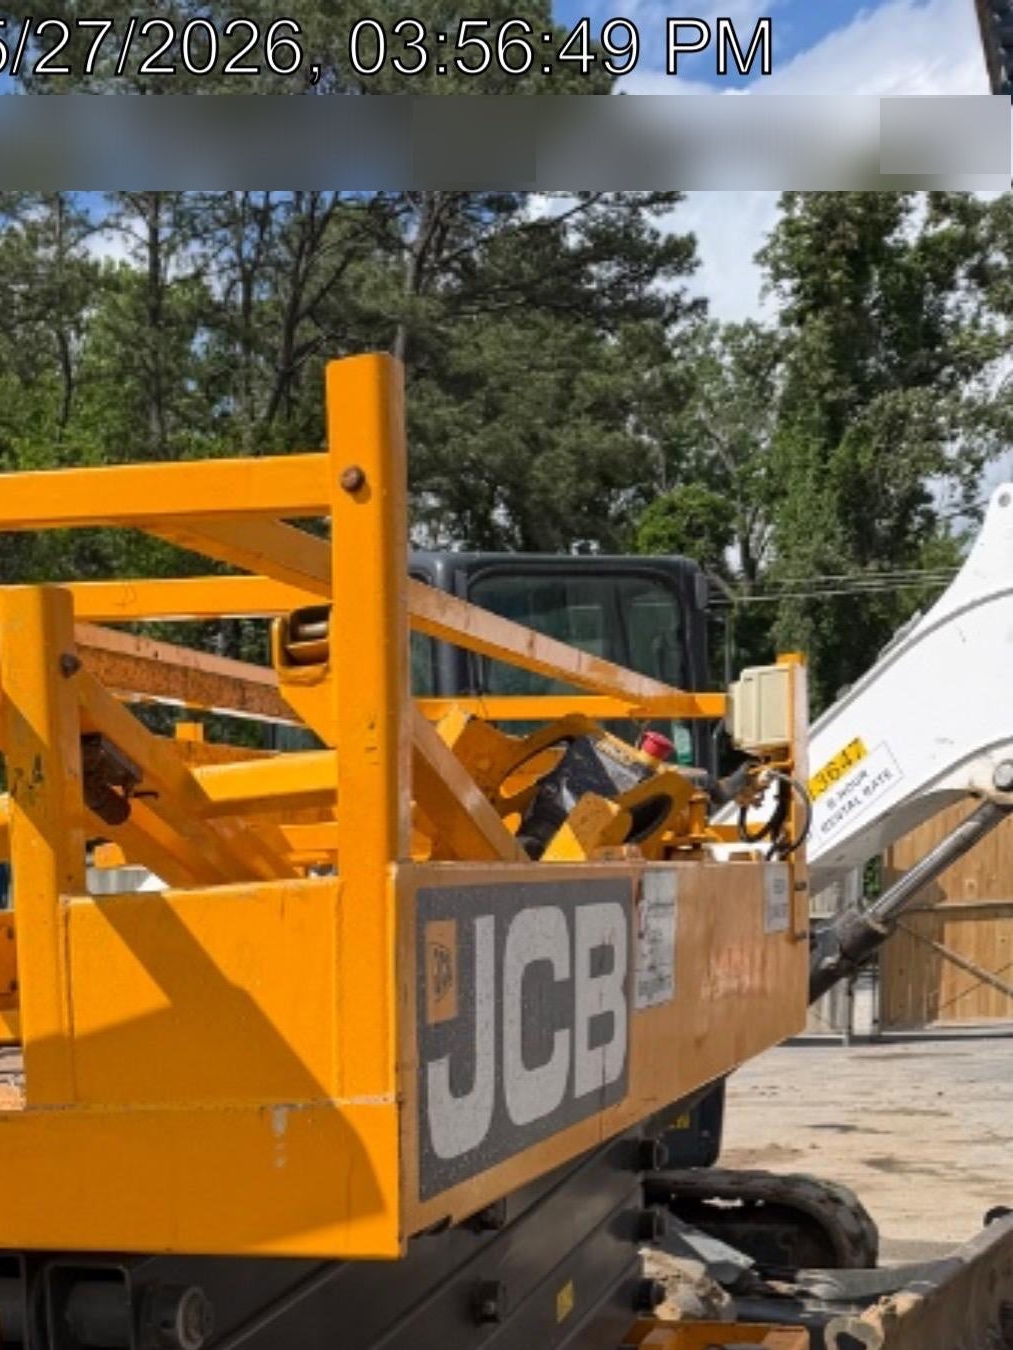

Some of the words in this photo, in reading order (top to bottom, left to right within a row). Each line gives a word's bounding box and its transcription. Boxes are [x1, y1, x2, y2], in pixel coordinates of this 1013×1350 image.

[820, 796, 862, 833] RENTAL
[862, 767, 893, 797] RATE
[426, 902, 628, 1159] JCB
